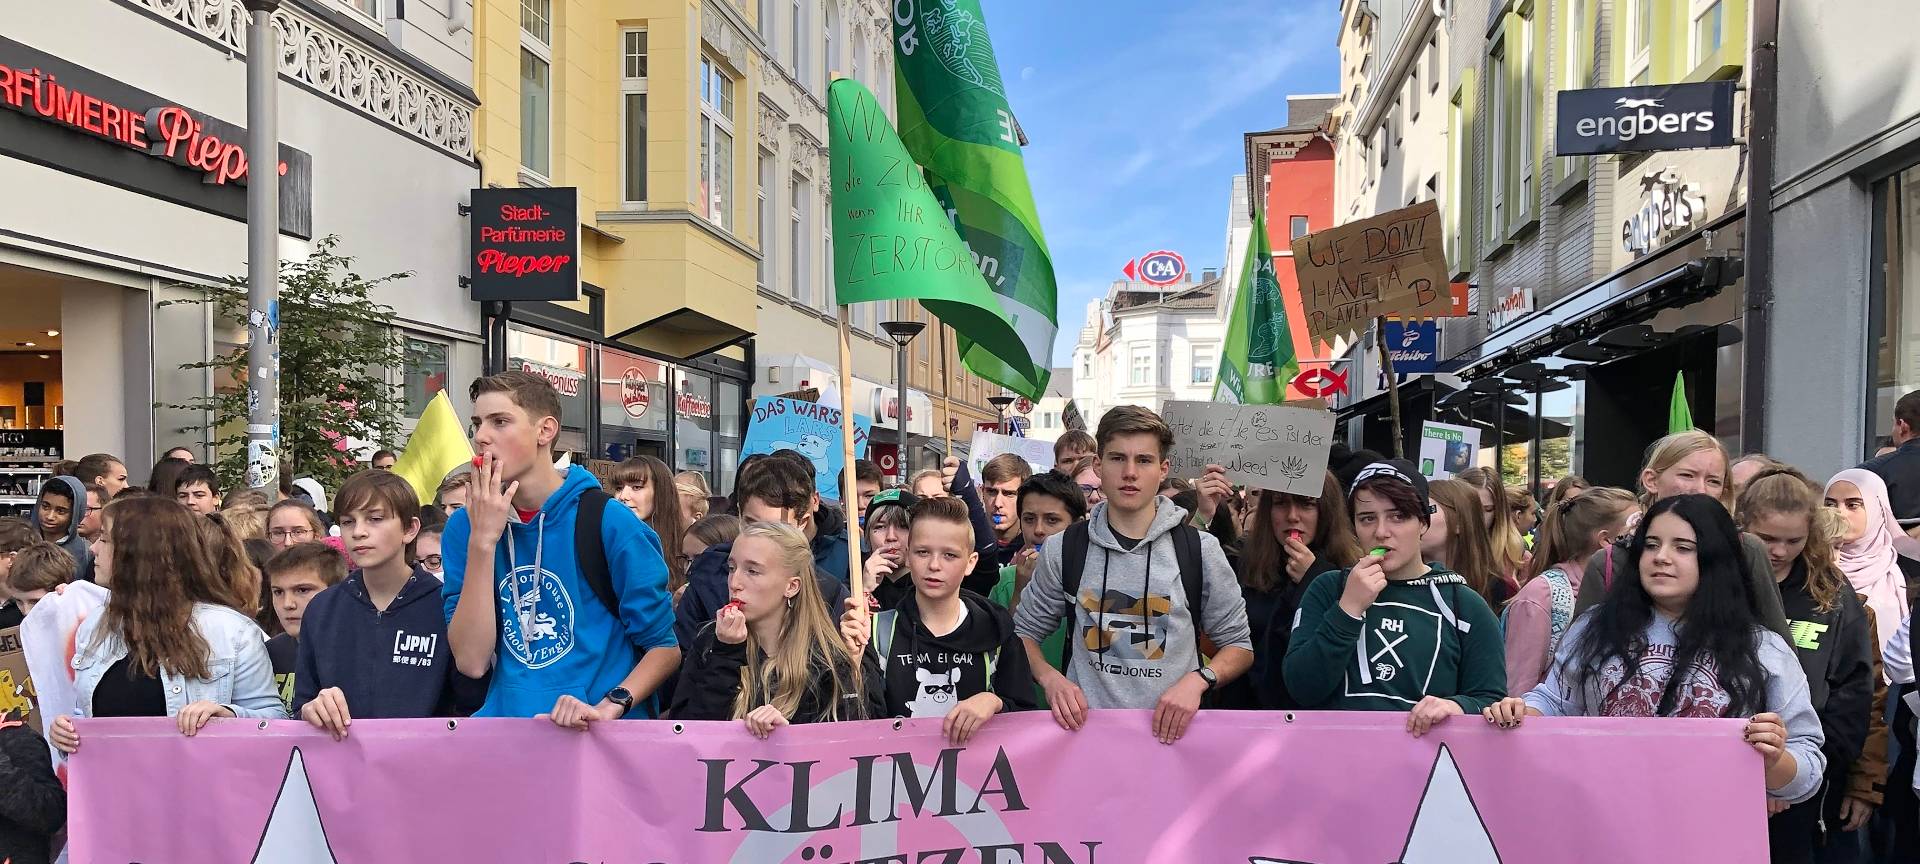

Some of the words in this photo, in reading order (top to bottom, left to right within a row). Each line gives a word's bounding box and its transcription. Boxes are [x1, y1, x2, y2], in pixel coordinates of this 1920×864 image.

[1576, 108, 1715, 141] engbers
[158, 106, 287, 186] Piep
[501, 204, 550, 221] Stadt-
[898, 198, 925, 225] IHR
[481, 226, 566, 243] Parfümerie
[477, 249, 570, 278] Pieper
[1307, 234, 1353, 267] WE
[1147, 261, 1177, 276] C&A
[1312, 272, 1373, 309] HAVE
[1387, 264, 1403, 289] A
[1407, 278, 1437, 308] B
[1389, 350, 1433, 361] Tchibo
[755, 398, 786, 424] DAS
[784, 417, 837, 439] LARS
[1255, 426, 1280, 442] es
[1302, 432, 1325, 447] der
[1424, 427, 1443, 439] There
[1444, 431, 1452, 441] Is
[1452, 432, 1462, 442] No
[503, 619, 530, 655] Schoo
[1380, 617, 1404, 633] RH
[1122, 666, 1163, 679] JONES
[694, 744, 1030, 834] KLIMA
